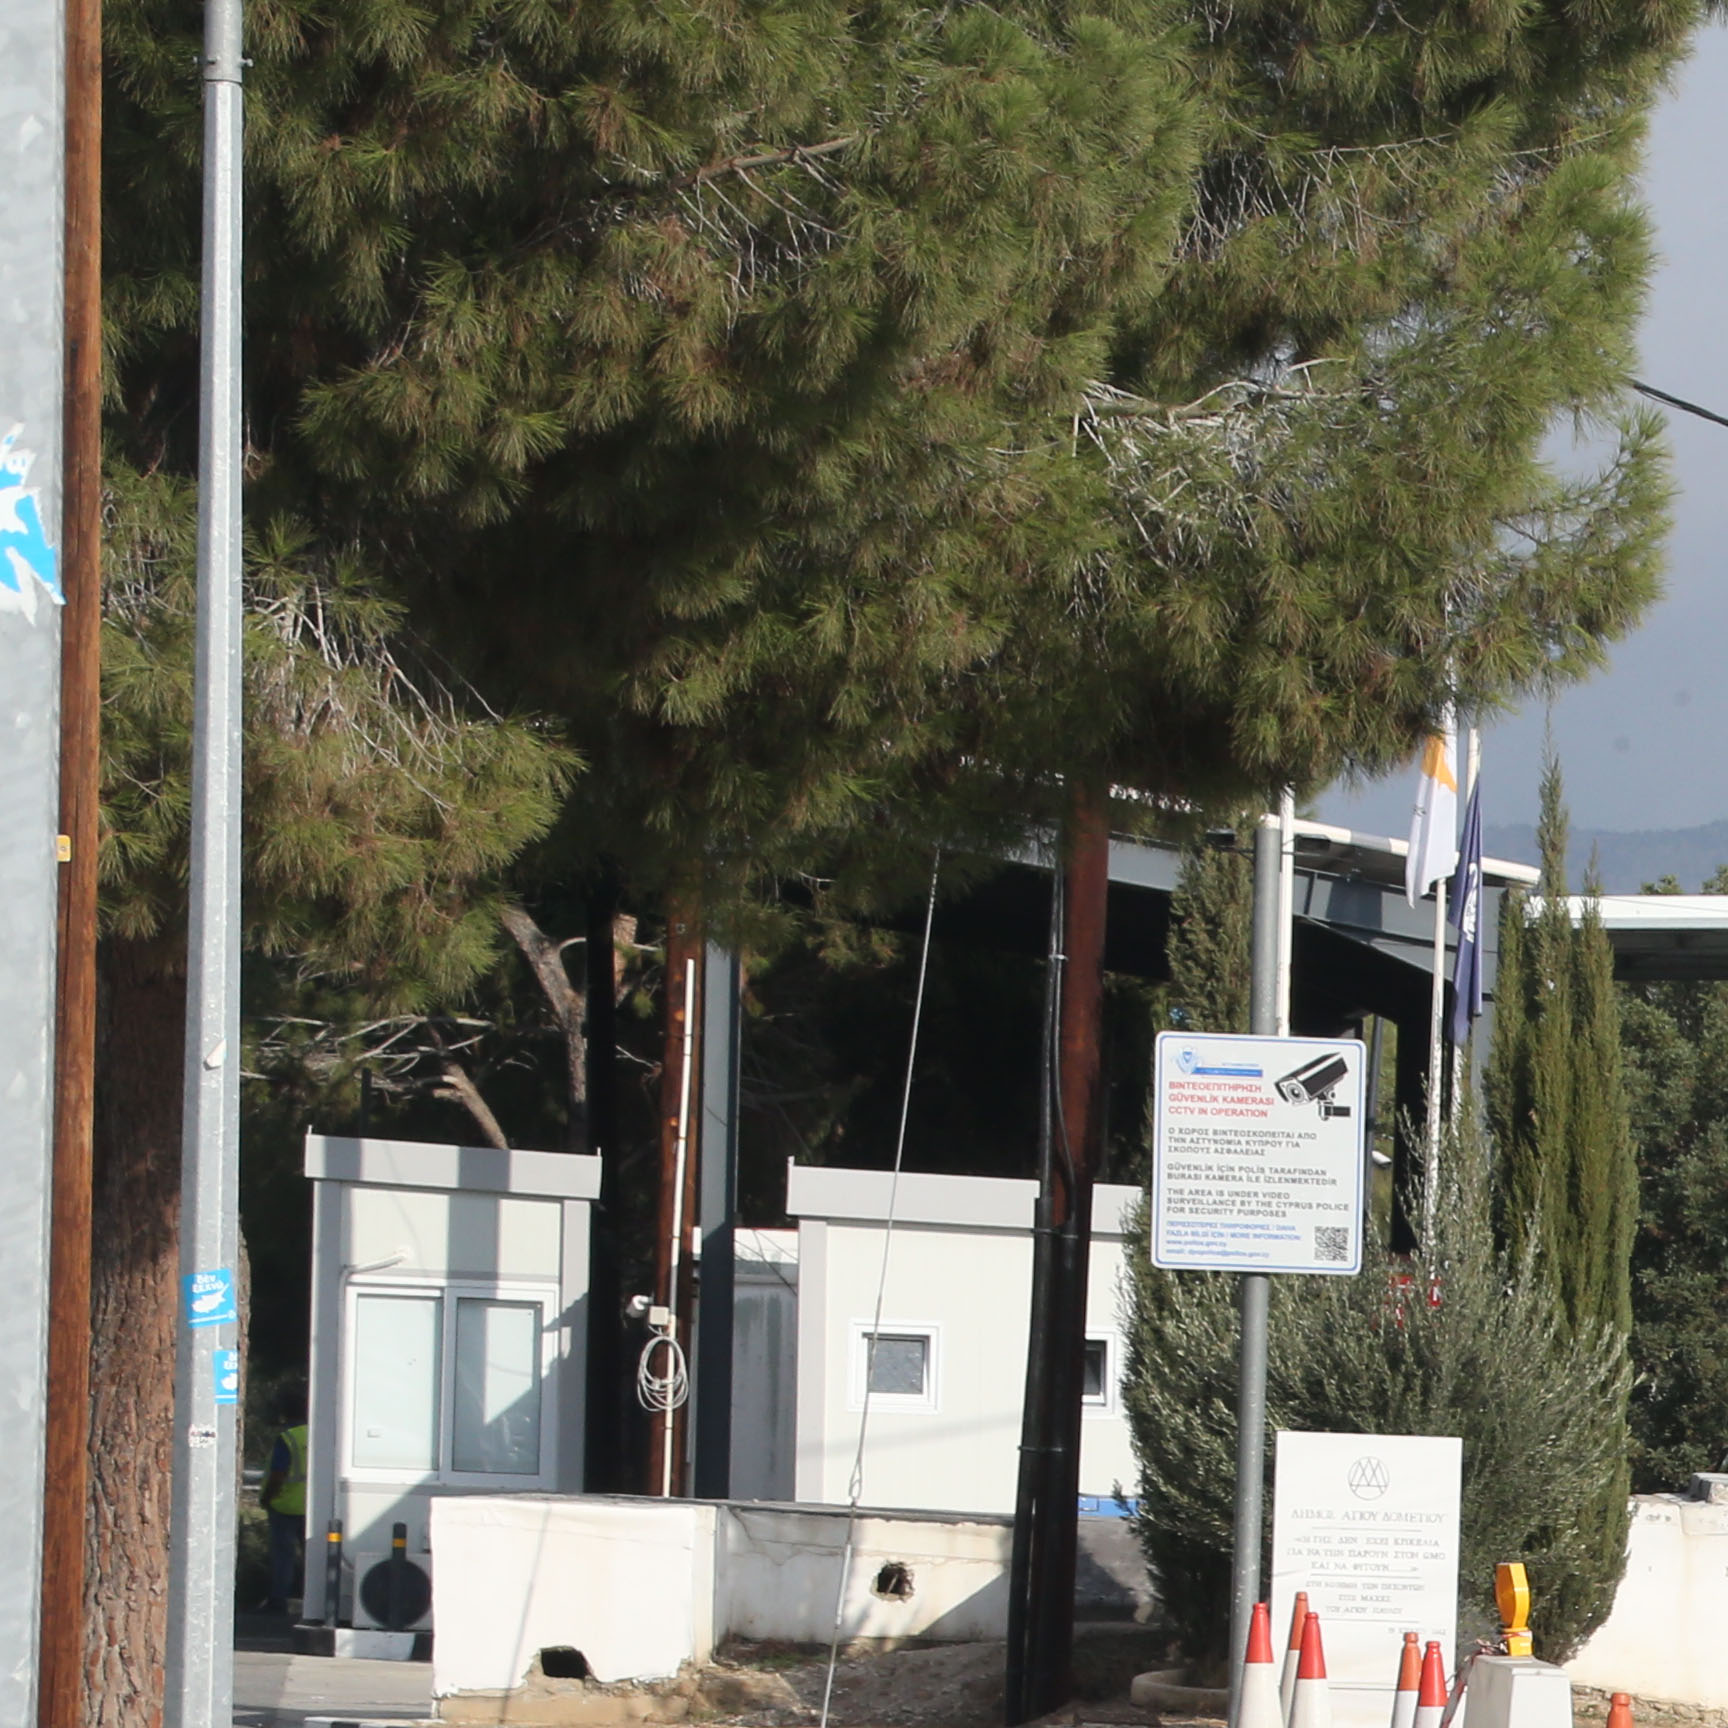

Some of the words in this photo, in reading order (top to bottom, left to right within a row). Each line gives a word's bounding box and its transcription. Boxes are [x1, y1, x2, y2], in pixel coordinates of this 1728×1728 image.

[1169, 1081, 1262, 1093] ΒΙΝΤΕΟΕΠΙΤΗΡΗΣΗ
[1168, 1092, 1219, 1104] GÜVENLİK
[1222, 1096, 1275, 1106] KAMERASI
[1168, 1106, 1196, 1116] CCTV
[1198, 1107, 1208, 1116] IN
[1210, 1108, 1269, 1118] OPERATION
[1178, 1128, 1210, 1136] ΧΩΡΟΣ
[1212, 1128, 1295, 1139] ΒΙΝΤΕΟΣΚΟΠΕΙΤΑΙ
[1297, 1132, 1317, 1140] ΑΠΟ
[1168, 1136, 1186, 1144] ΤΗΝ
[1189, 1137, 1242, 1146] ΑΣΤΥΝΟΜΙΑ
[1245, 1140, 1283, 1148] ΚΥΠΡΟΥ
[1167, 1146, 1211, 1154] ΣΚΟΠΟΥΣ
[1213, 1148, 1266, 1156] ΑΣΦΑΛΕΙΑΣ
[1167, 1162, 1214, 1172] GÜVENLİK
[1217, 1164, 1235, 1175] İÇİN
[1238, 1165, 1265, 1174] POLİS
[1268, 1167, 1327, 1176] TARAFINDAN
[1167, 1172, 1202, 1181] BURASI
[1204, 1174, 1244, 1183] KAMERA
[1246, 1174, 1261, 1184] İLE
[1264, 1176, 1337, 1186] İZLENMEKTEDİR
[1167, 1188, 1184, 1196] THE
[1187, 1189, 1213, 1197] AREA
[1216, 1190, 1225, 1198] IS
[1228, 1190, 1259, 1199] UNDER
[1262, 1192, 1290, 1200] VIDEO
[1166, 1198, 1236, 1207] SURVEILLANCE
[1254, 1200, 1273, 1208] THE
[1275, 1201, 1313, 1210] CYPRUS
[1316, 1203, 1350, 1212] POLICE
[1166, 1206, 1186, 1214] FOR
[1188, 1207, 1234, 1216] SECURITY
[1237, 1209, 1287, 1218] PURPOSES
